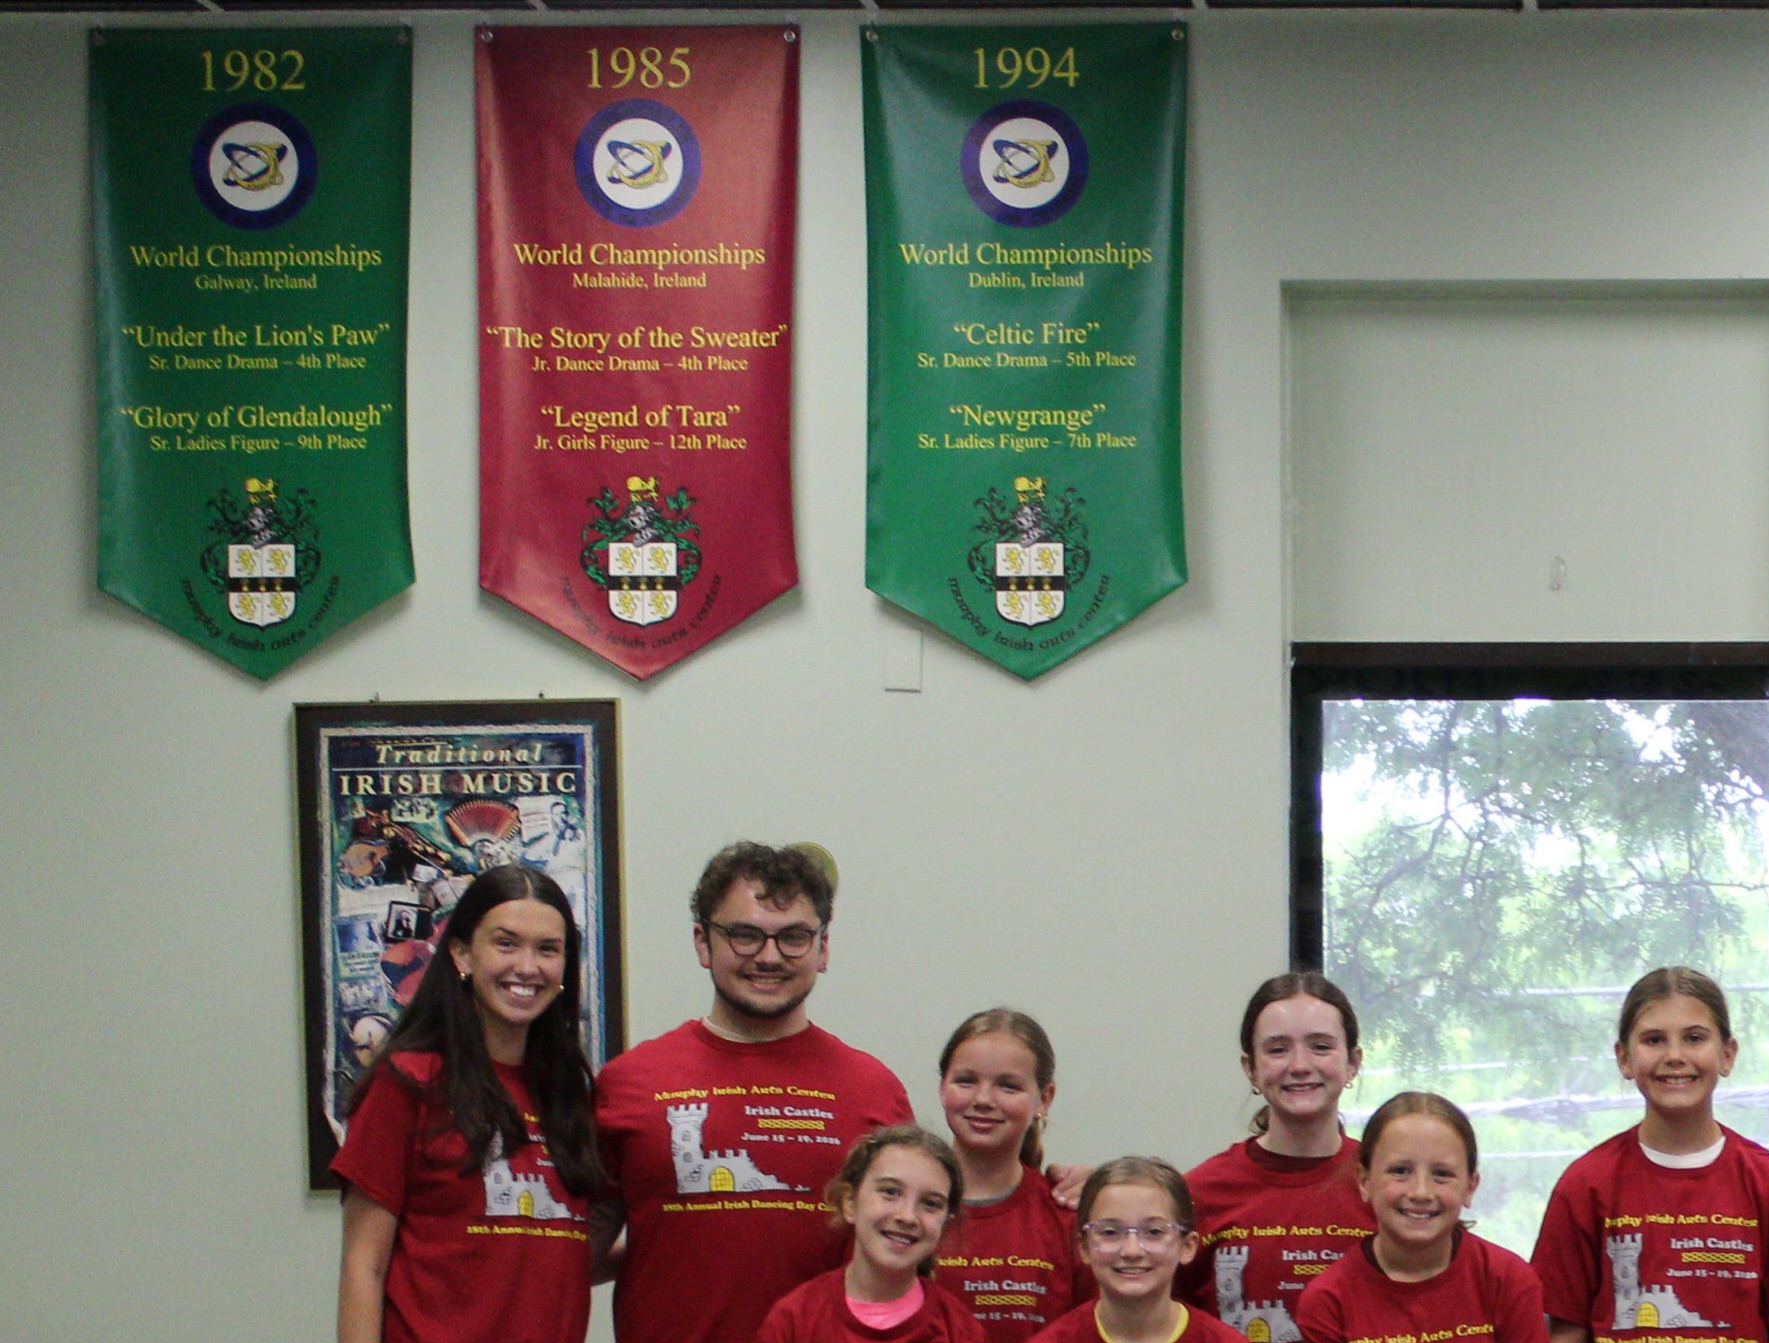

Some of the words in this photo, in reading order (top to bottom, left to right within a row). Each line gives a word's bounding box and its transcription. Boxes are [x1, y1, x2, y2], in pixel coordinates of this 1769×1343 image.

[202, 50, 304, 90] 1982
[588, 48, 691, 89] 1985
[975, 47, 1079, 88] 1994
[130, 245, 199, 267] World
[206, 244, 382, 272] Championships
[513, 243, 583, 265] World
[590, 242, 765, 271] Championships
[900, 243, 969, 265] World
[975, 242, 1153, 271] Championships
[195, 275, 259, 292] Galway,
[263, 274, 317, 289] Ireland
[573, 272, 648, 288] Malahide,
[654, 272, 707, 287] Ireland
[968, 272, 1025, 288] Dublin,
[1031, 272, 1084, 287] Ireland
[121, 325, 206, 347] “Under
[212, 325, 247, 346] the
[255, 324, 324, 346] Lion's
[331, 323, 389, 345] Paw”
[487, 326, 543, 349] “The
[551, 327, 611, 353] Story
[618, 326, 644, 348] of
[649, 327, 683, 347] the
[691, 325, 786, 348] Sweater”
[954, 323, 1034, 345] “Celtic
[1041, 321, 1099, 344] Fire”
[149, 355, 169, 369] Sr.
[175, 355, 222, 369] Dance
[227, 354, 278, 369] Drama
[296, 354, 321, 368] 4th
[326, 354, 366, 368] Place
[532, 356, 550, 371] Jr.
[556, 356, 604, 371] Dance
[609, 356, 660, 371] Drama
[678, 356, 702, 370] 4th
[708, 356, 748, 370] Place
[918, 353, 938, 367] Sr.
[944, 353, 991, 367] Dance
[996, 352, 1047, 367] Drama
[1067, 352, 1091, 366] 5th
[1096, 352, 1137, 366] Place
[120, 406, 199, 433] “Glory
[207, 406, 234, 427] of
[237, 404, 392, 432] Glendalough”
[541, 405, 638, 433] “Legend
[645, 405, 672, 426] of
[676, 405, 740, 426] Tara”
[949, 403, 1107, 432] “Newgrange”
[150, 435, 170, 450] Sr.
[176, 435, 226, 450] Ladies
[231, 435, 280, 453] Figure
[297, 435, 322, 449] 9th
[327, 434, 367, 449] Place
[534, 435, 553, 449] Jr.
[557, 434, 596, 449] Girls
[600, 435, 649, 453] Figure
[671, 435, 702, 449] 12th
[706, 434, 747, 449] Place
[919, 434, 939, 448] Sr.
[944, 434, 995, 448] Ladies
[999, 434, 1049, 452] Figure
[1068, 433, 1091, 448] 7th
[1096, 433, 1136, 447] Place
[376, 743, 543, 764] Traditional
[340, 774, 441, 796] IRISH
[462, 772, 576, 793] MUSIC
[654, 1088, 708, 1101] Murphy
[713, 1086, 746, 1096] Irish
[751, 1085, 783, 1095] Arts
[787, 1086, 836, 1100] Center
[744, 1105, 781, 1116] Irish
[783, 1106, 834, 1119] Castles
[741, 1133, 768, 1142] June
[686, 1202, 721, 1211] Annual
[724, 1201, 750, 1210] Irish
[752, 1200, 795, 1211] Dancing
[796, 1201, 815, 1212] Day
[1677, 1215, 1708, 1224] Arts
[1711, 1214, 1758, 1227] Center
[1671, 1238, 1704, 1249] Irish
[1707, 1238, 1754, 1251] Castles
